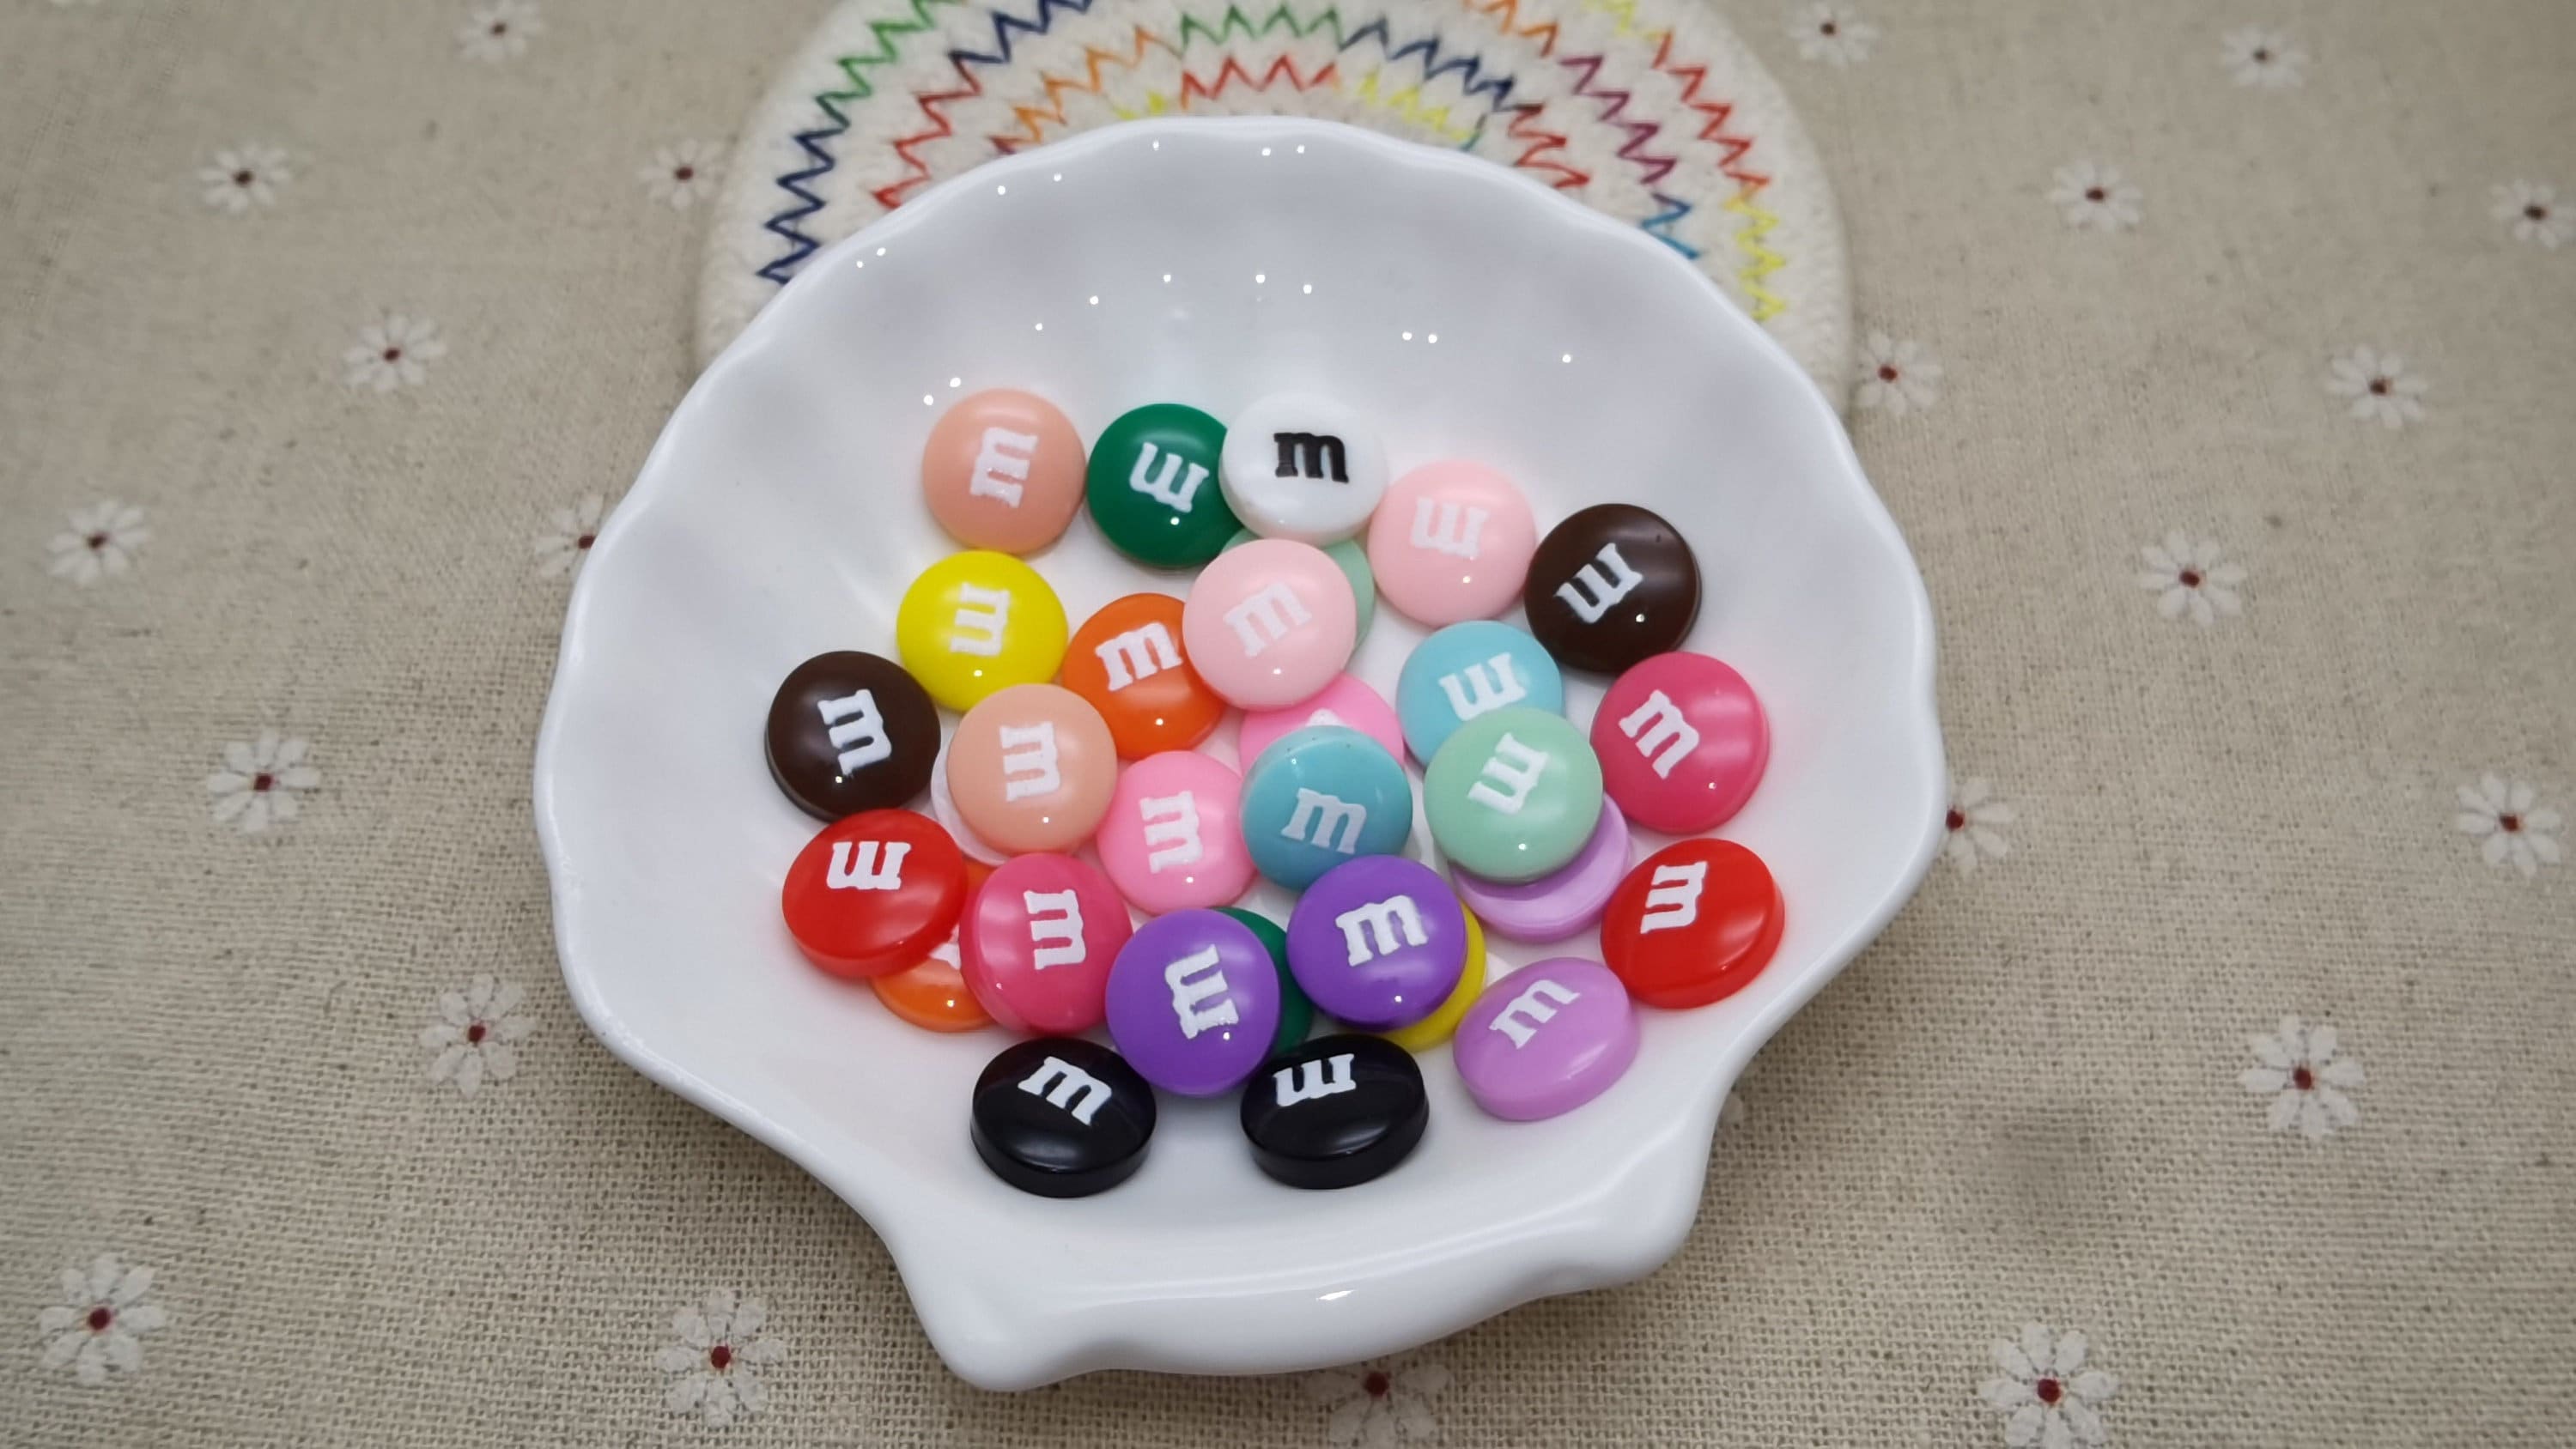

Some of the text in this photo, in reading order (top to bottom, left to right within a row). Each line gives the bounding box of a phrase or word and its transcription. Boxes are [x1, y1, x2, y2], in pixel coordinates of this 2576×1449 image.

[1273, 432, 1349, 483] m
[1224, 582, 1313, 657] m
[1095, 621, 1183, 690] m
[1619, 688, 1700, 779] m
[1280, 787, 1367, 855] m
[1334, 894, 1429, 967] m
[1489, 979, 1581, 1049] m
[1018, 1055, 1113, 1126] m
